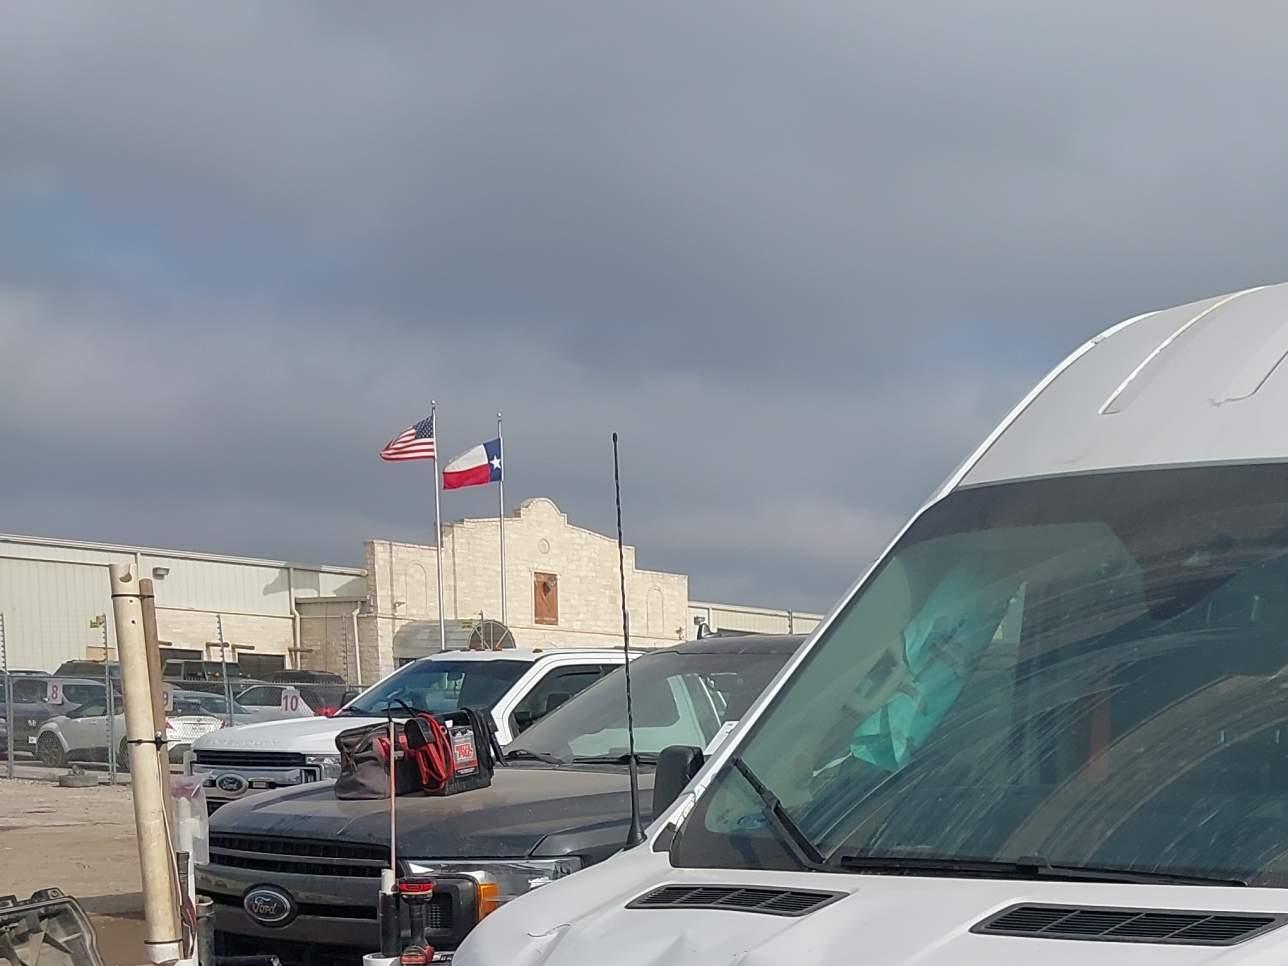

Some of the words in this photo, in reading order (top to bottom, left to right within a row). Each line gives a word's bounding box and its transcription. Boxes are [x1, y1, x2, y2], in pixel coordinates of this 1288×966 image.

[50, 685, 58, 700] 8
[282, 695, 299, 712] 10
[252, 896, 277, 915] Ford
